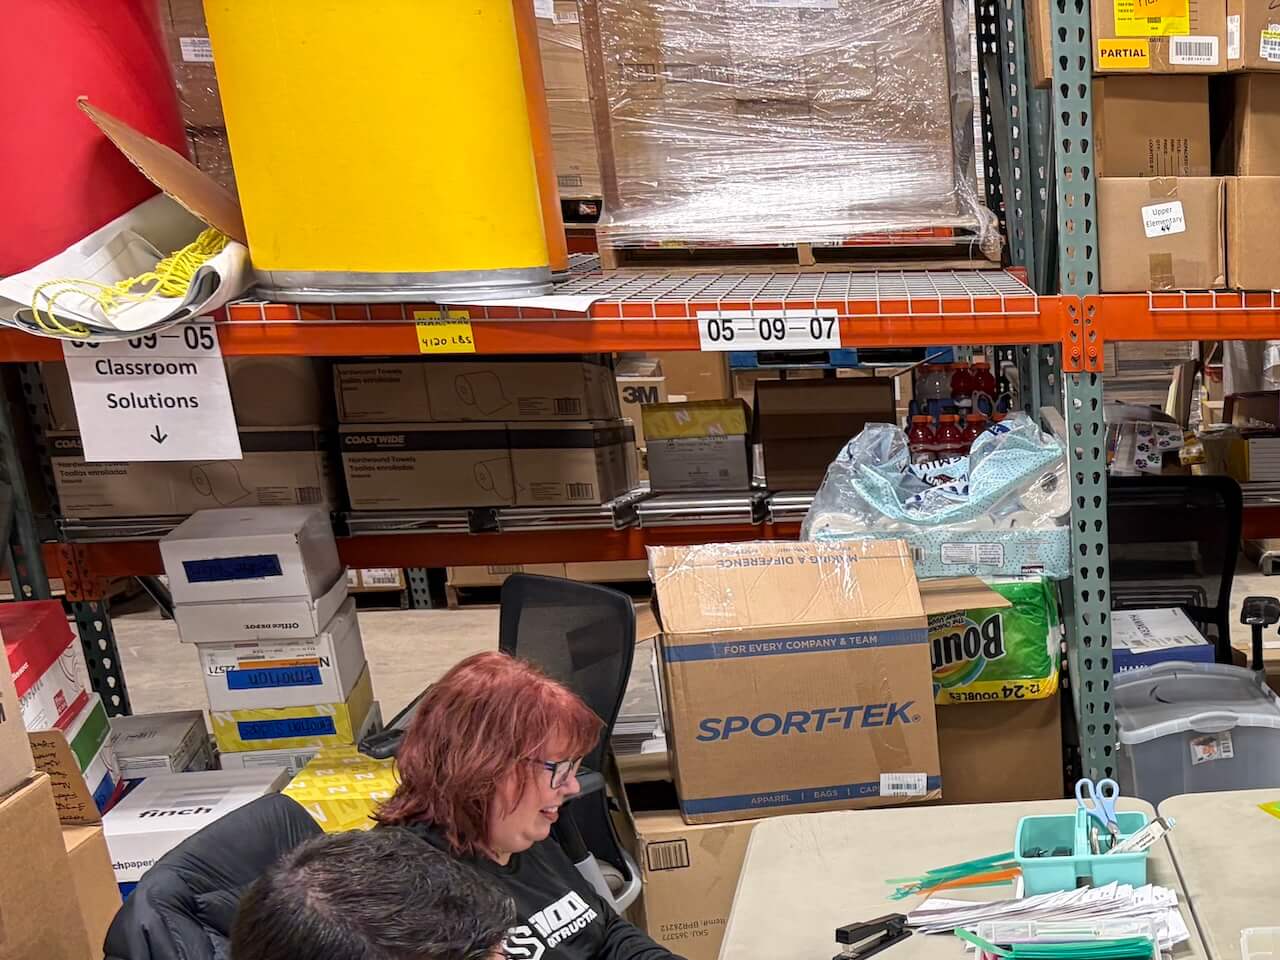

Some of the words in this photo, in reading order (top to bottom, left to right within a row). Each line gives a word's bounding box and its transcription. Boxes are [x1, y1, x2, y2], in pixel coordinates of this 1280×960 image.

[1101, 49, 1146, 58] PARTIAL
[1151, 206, 1173, 217] Upper
[1146, 215, 1183, 228] Elementary
[707, 318, 836, 342] 05-09-07
[422, 338, 447, 348] 4120
[95, 358, 198, 376] Classroom
[106, 392, 199, 409] Solutions
[623, 386, 659, 404] 3M
[344, 435, 405, 445] COASTWIDE
[391, 455, 416, 463] Towels
[716, 556, 795, 570] DIFFERENCE
[796, 555, 805, 564] A
[272, 622, 300, 630] Office
[723, 645, 747, 655] FOR
[749, 642, 783, 654] EVERY
[785, 639, 837, 652] COMPANY
[839, 637, 848, 647] &
[848, 634, 878, 647] TEAM
[695, 700, 914, 742] SPORT-TEK
[750, 793, 792, 805] APPAREL
[813, 788, 839, 800] BAGS
[138, 806, 213, 818] finch
